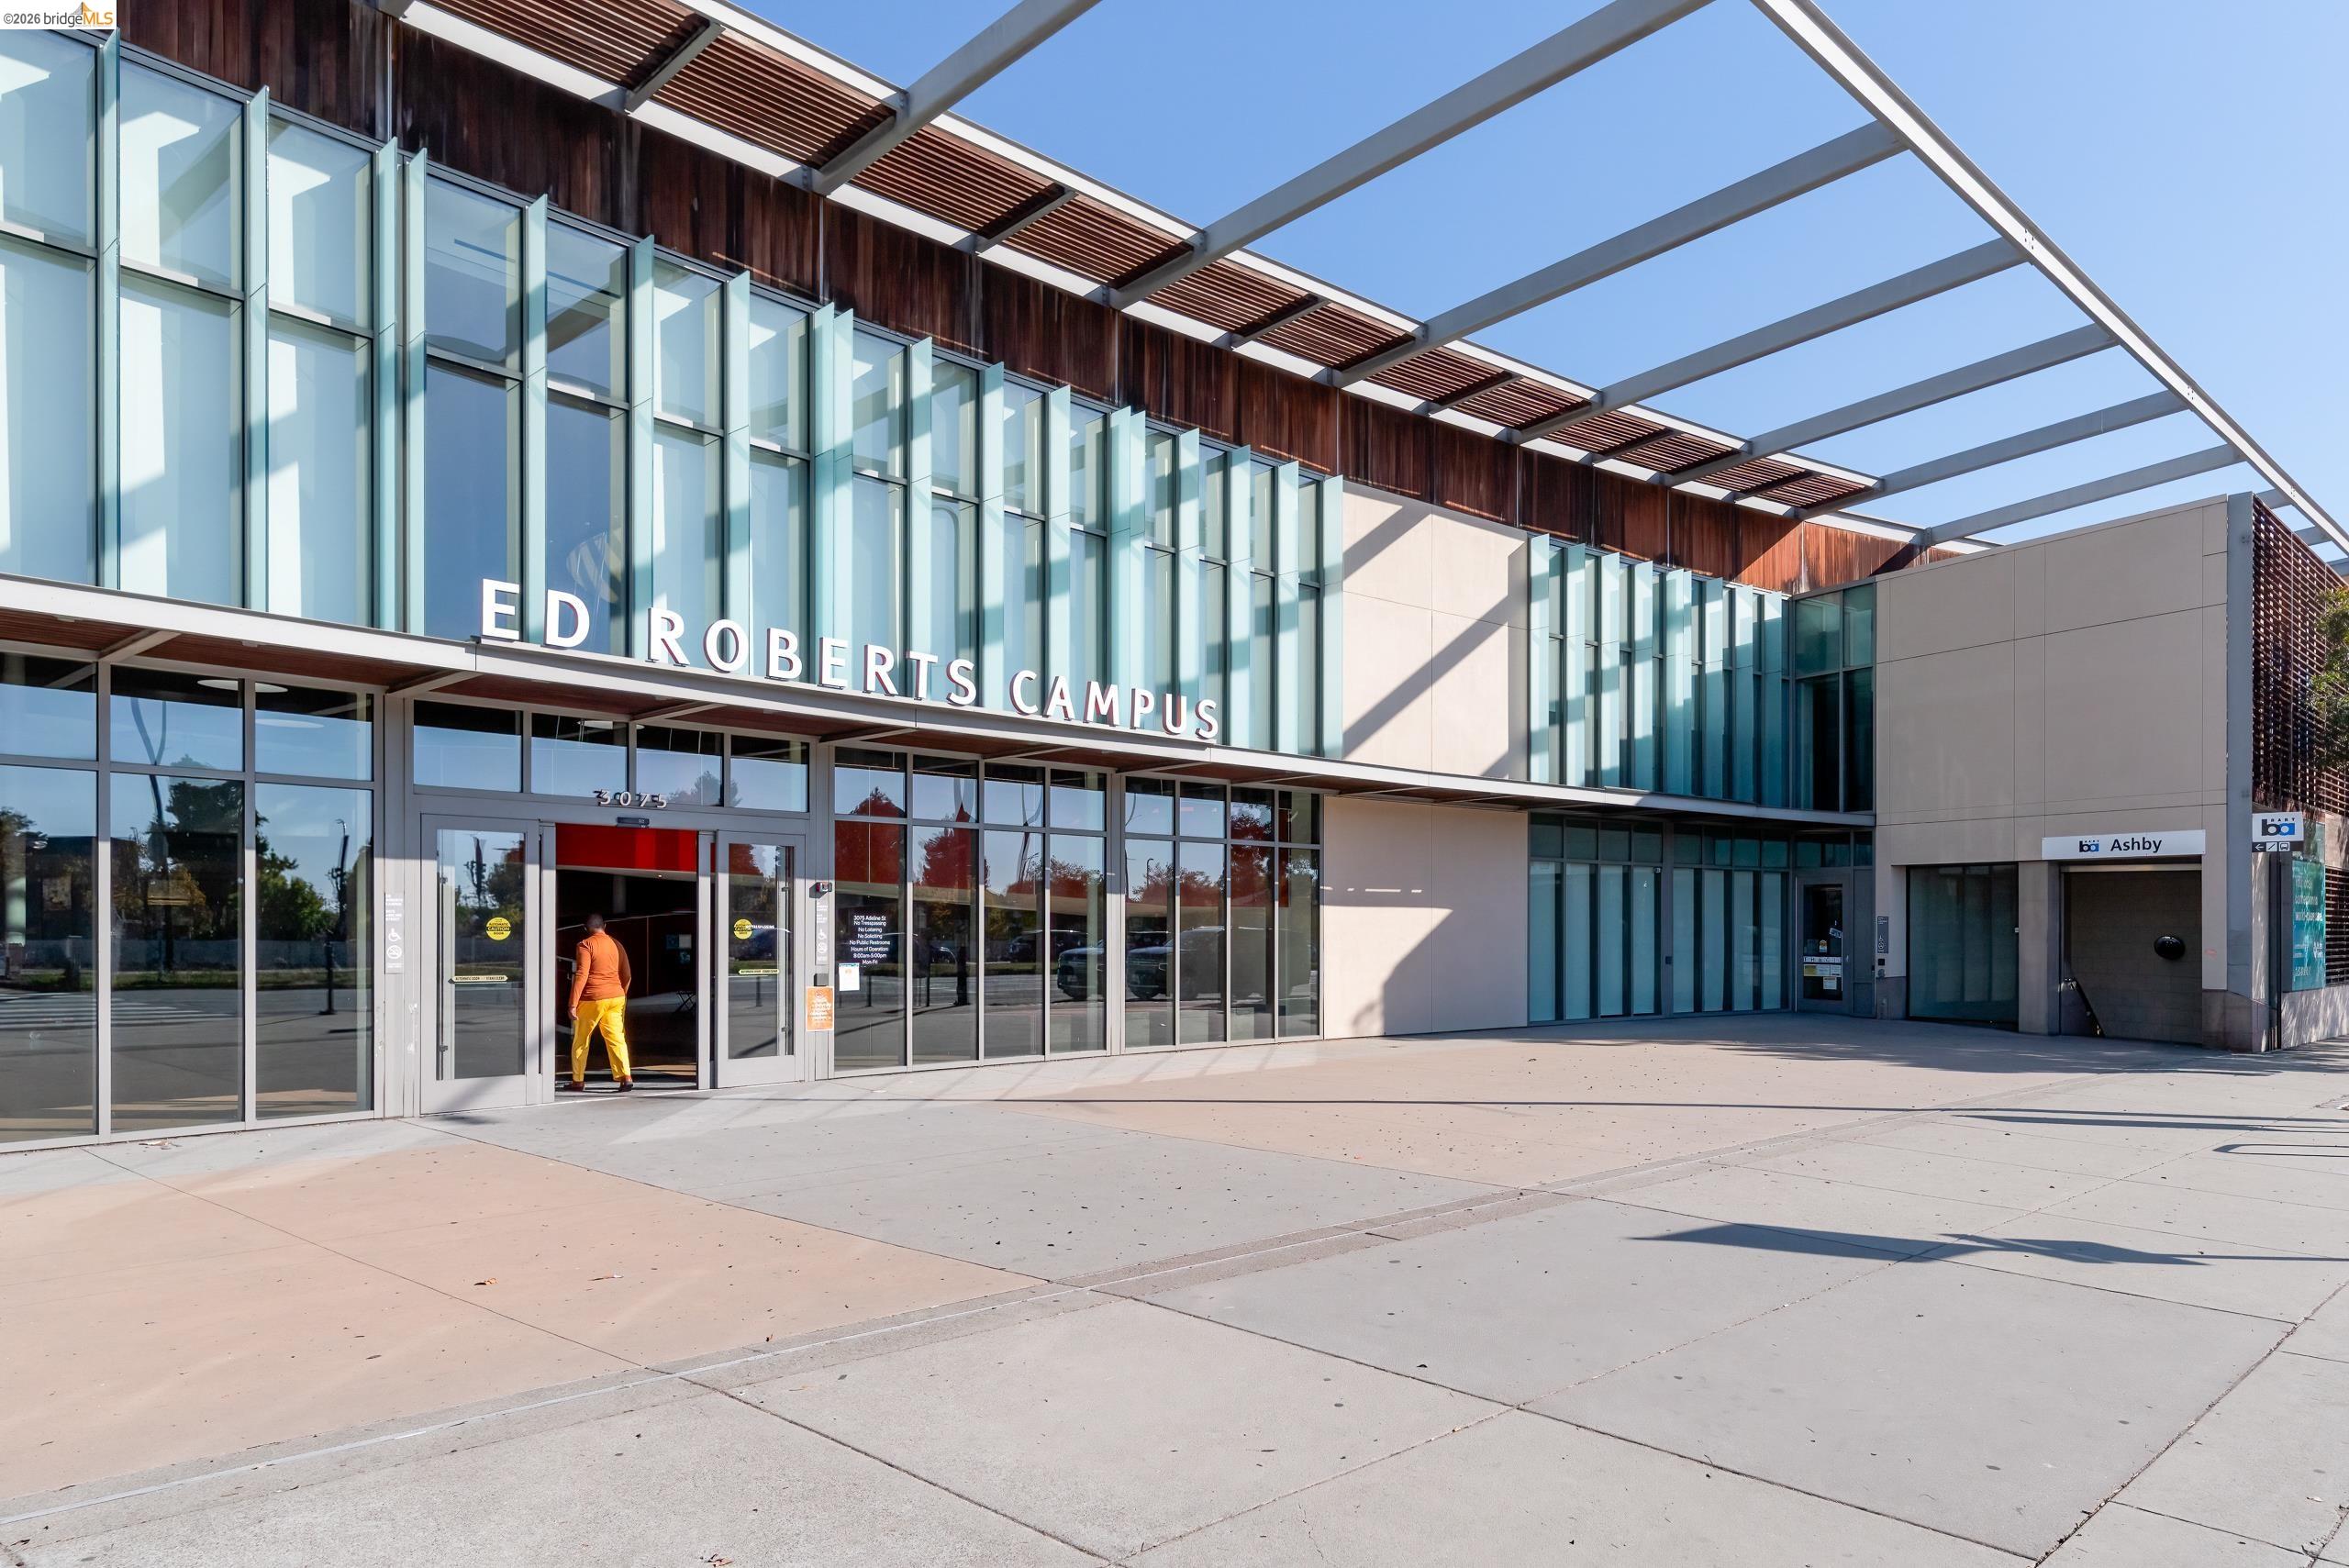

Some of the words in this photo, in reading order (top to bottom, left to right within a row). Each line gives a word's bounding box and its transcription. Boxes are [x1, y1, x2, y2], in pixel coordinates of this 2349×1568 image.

[481, 578, 590, 648] ED
[647, 606, 978, 706] ROBERTS
[1009, 670, 1219, 740] CAMPUS
[599, 789, 667, 808] 3075
[2110, 837, 2162, 853] Ashby
